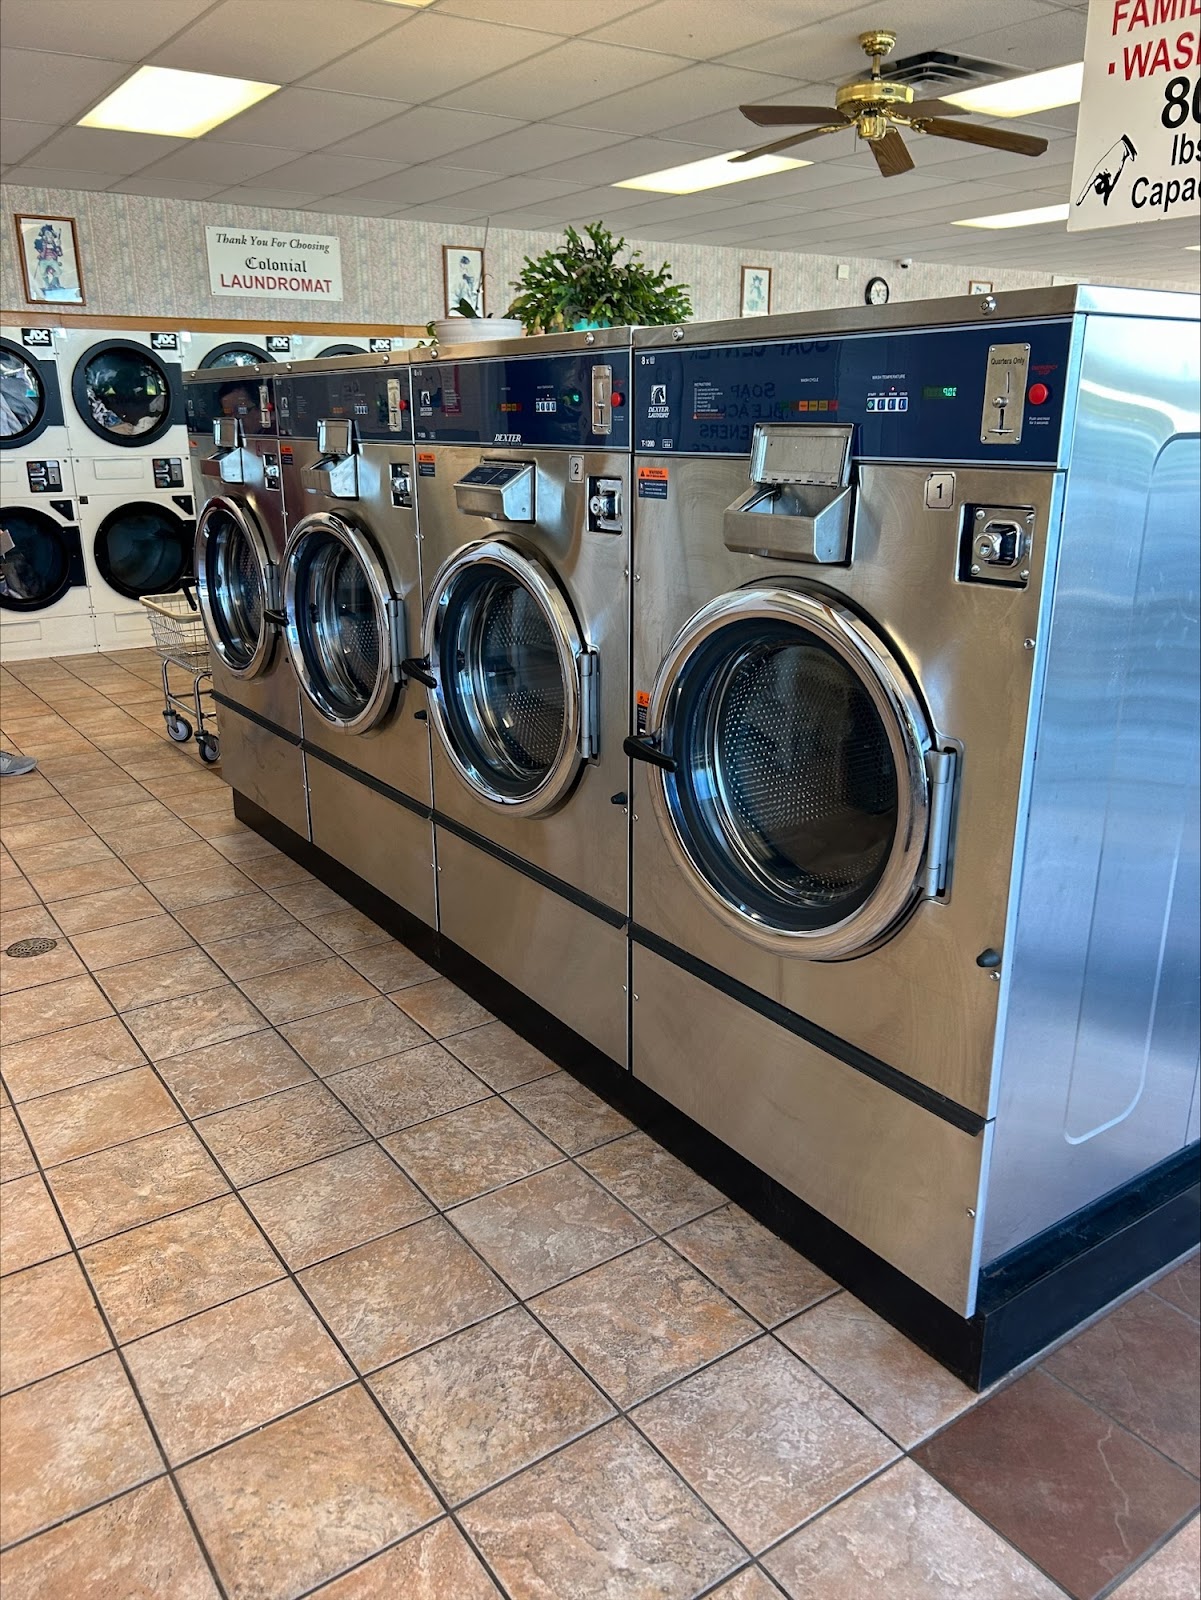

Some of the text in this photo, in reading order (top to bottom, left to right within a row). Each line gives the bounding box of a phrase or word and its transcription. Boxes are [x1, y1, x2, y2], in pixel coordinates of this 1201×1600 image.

[1123, 31, 1200, 81] WAS
[1131, 176, 1200, 213] Capa
[216, 233, 330, 254] Thank You For Choosing
[245, 256, 307, 273] Colonial
[220, 273, 332, 293] LAUNDROMAT
[1013, 357, 1026, 365] Only
[494, 433, 522, 442] DEXTER
[574, 463, 579, 475] 2
[936, 482, 943, 499] 1
